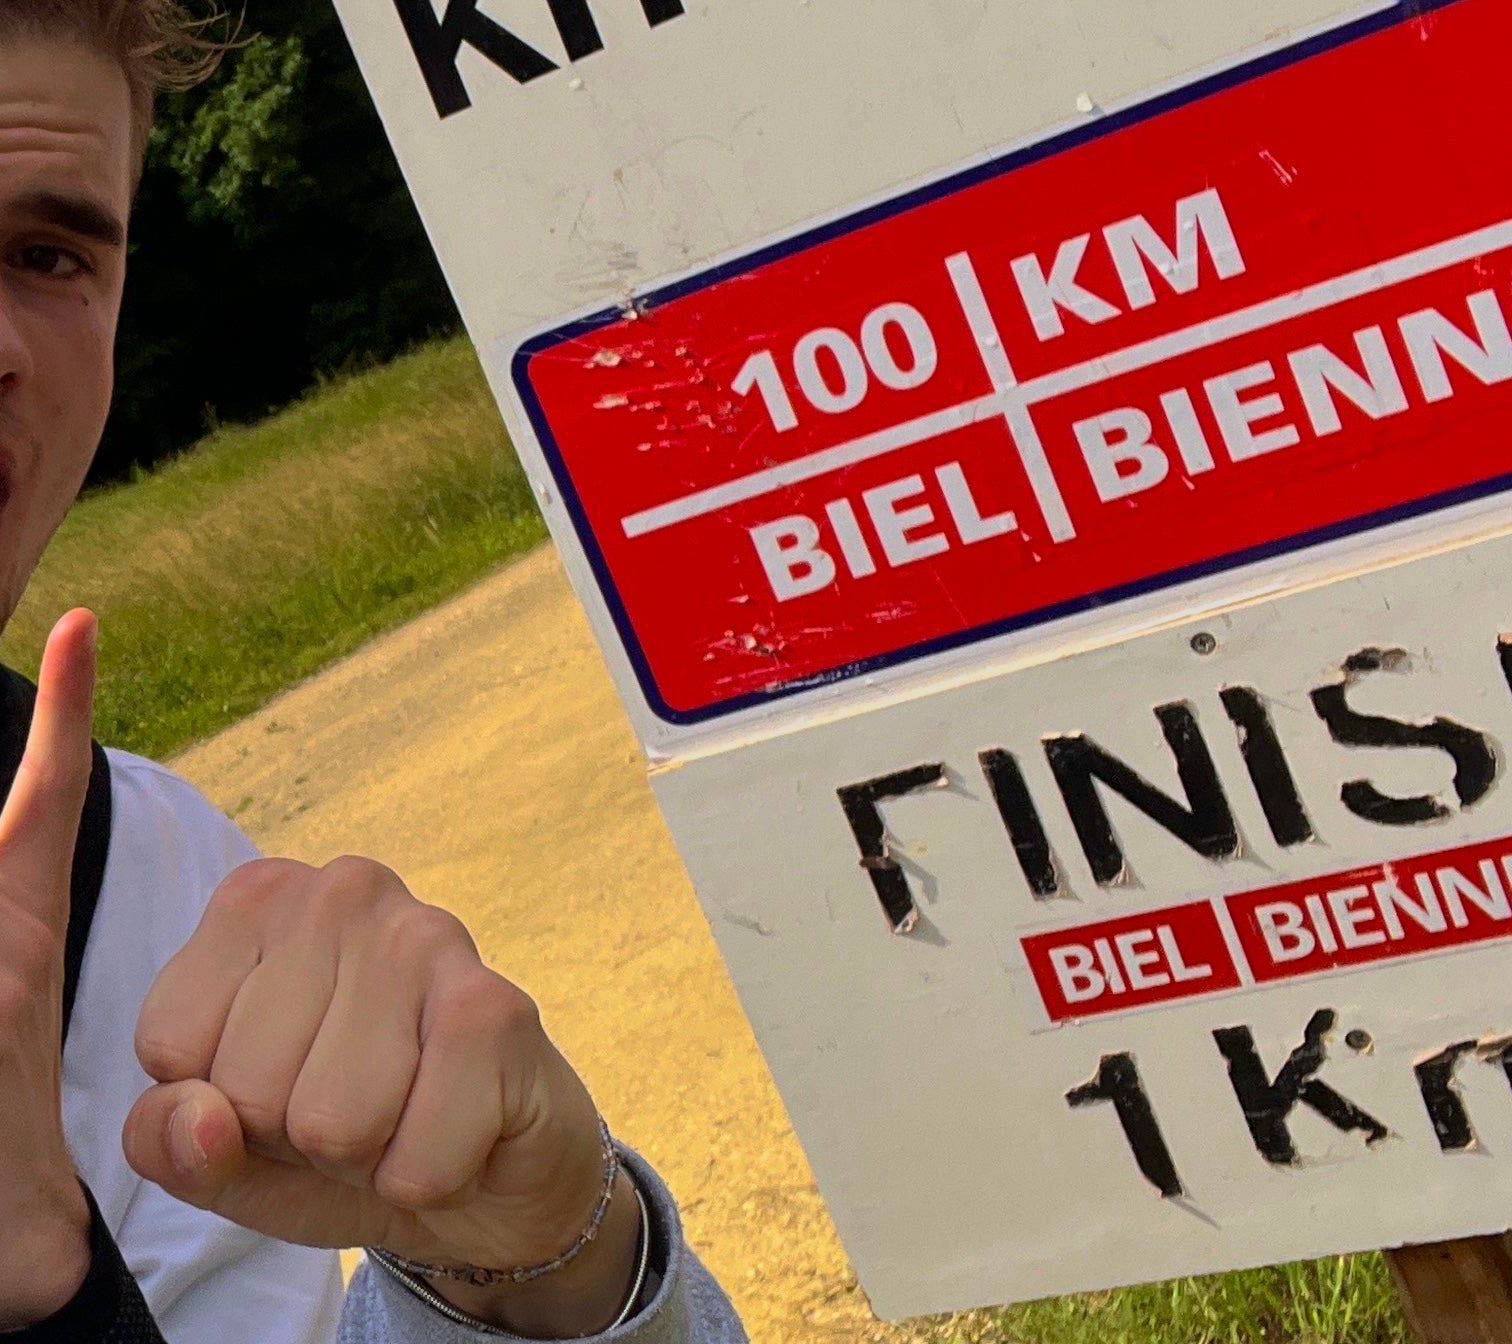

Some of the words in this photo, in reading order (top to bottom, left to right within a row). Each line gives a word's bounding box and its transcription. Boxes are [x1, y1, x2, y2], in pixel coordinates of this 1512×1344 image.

[730, 301, 939, 433] 100
[1010, 187, 1247, 341] KM
[749, 461, 1018, 602] BIEL
[836, 634, 1512, 934] FINIS
[1048, 924, 1213, 1004] BIEL
[1253, 854, 1512, 964] BIENN
[1065, 1052, 1184, 1198] 1
